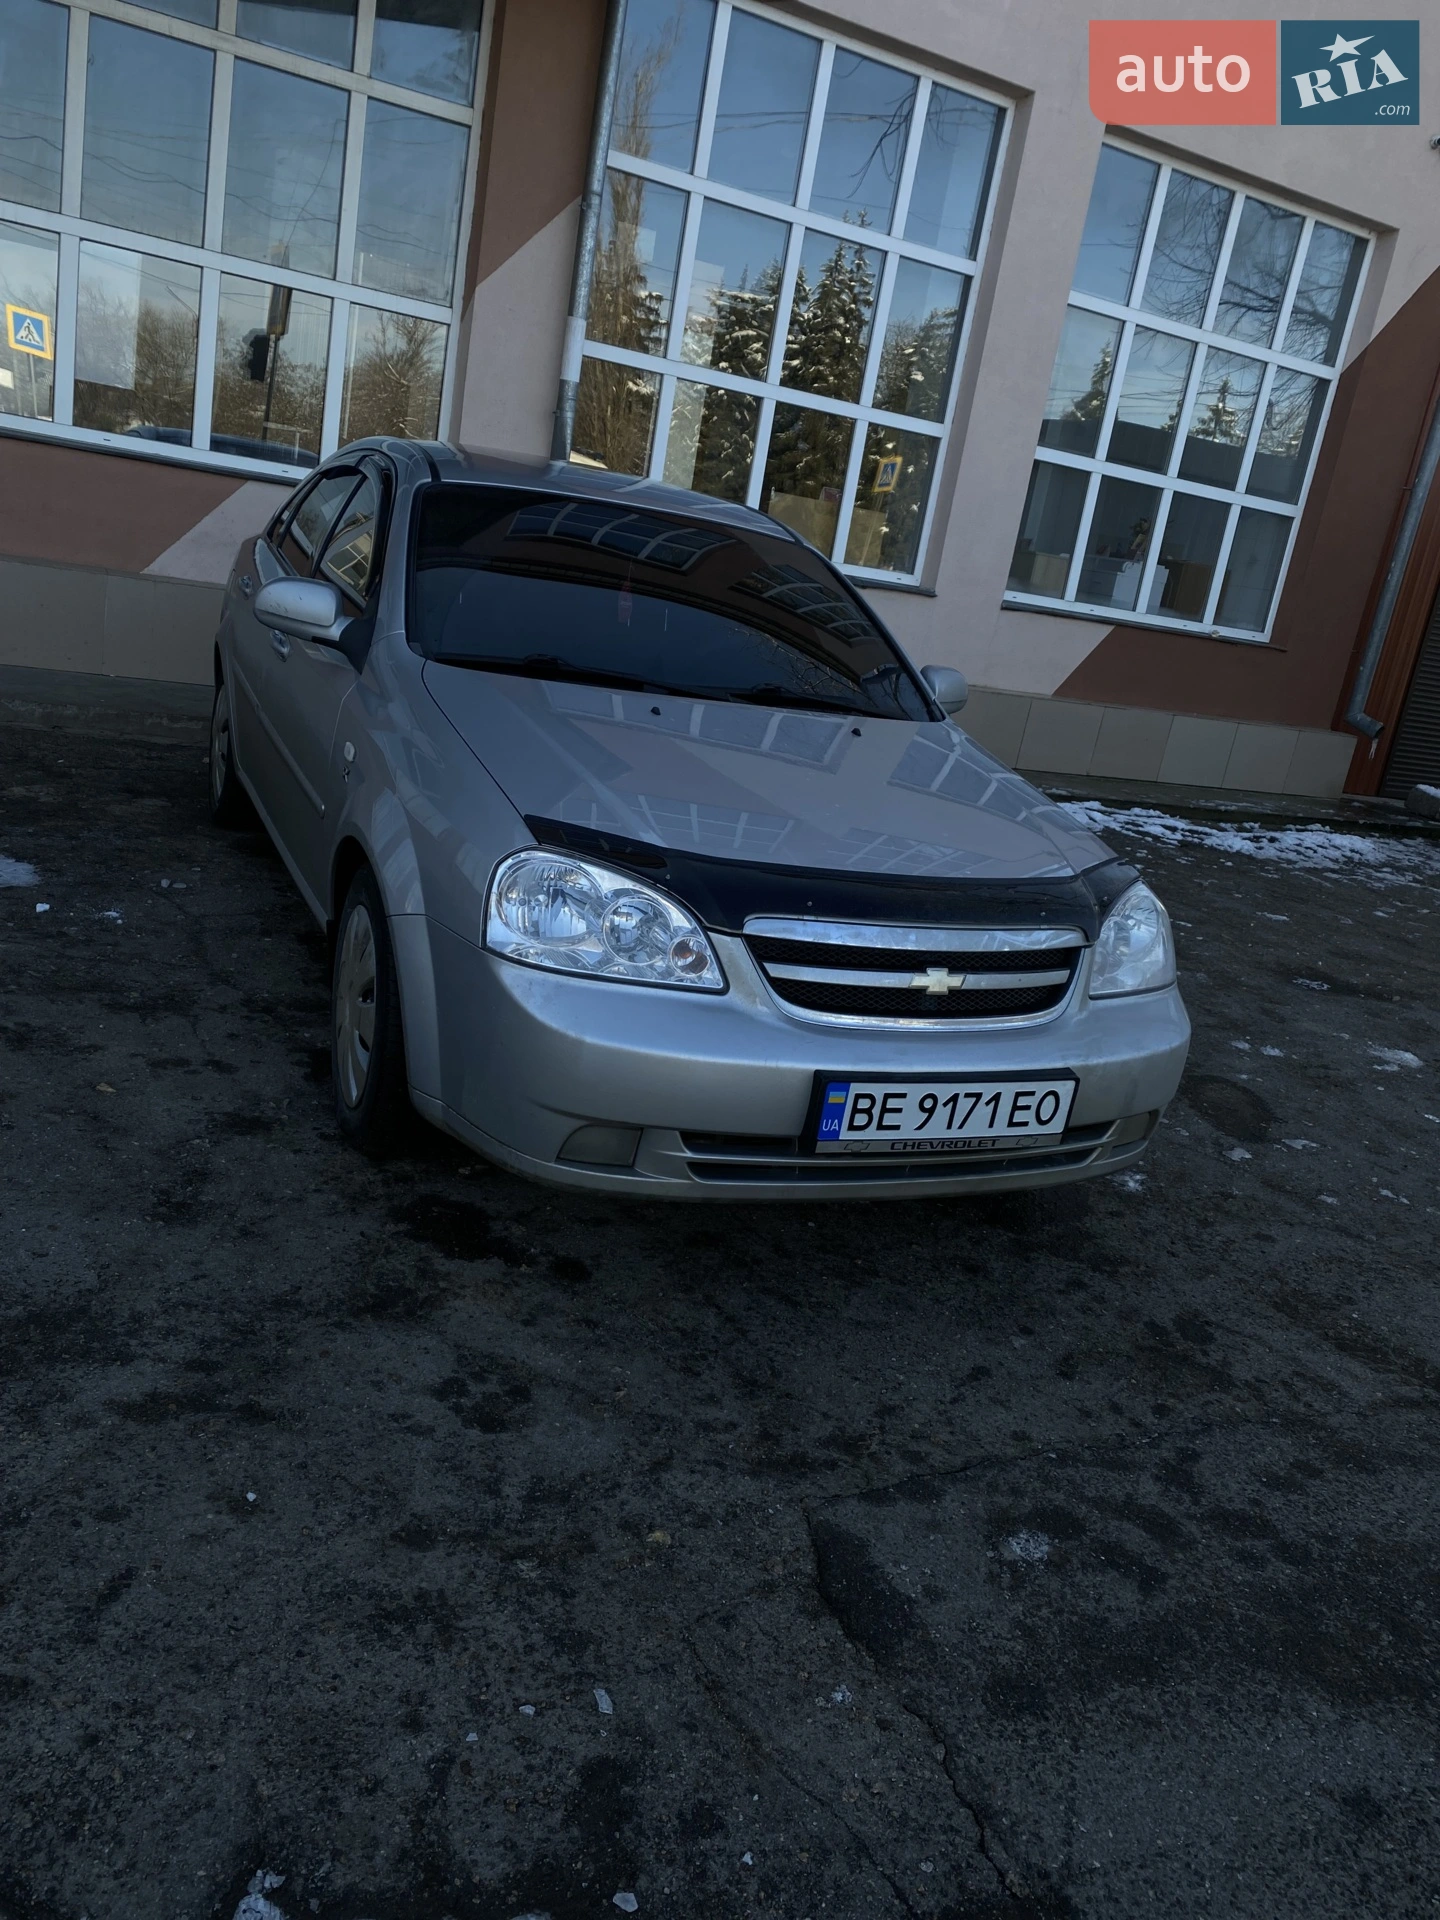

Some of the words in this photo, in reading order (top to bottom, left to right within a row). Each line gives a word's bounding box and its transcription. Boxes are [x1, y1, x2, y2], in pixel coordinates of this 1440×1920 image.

[847, 1092, 908, 1132] BE
[913, 1091, 1003, 1131] 9171
[1006, 1089, 1061, 1128] EO
[822, 1118, 840, 1132] UA
[890, 1138, 1000, 1151] CHEVROLET
